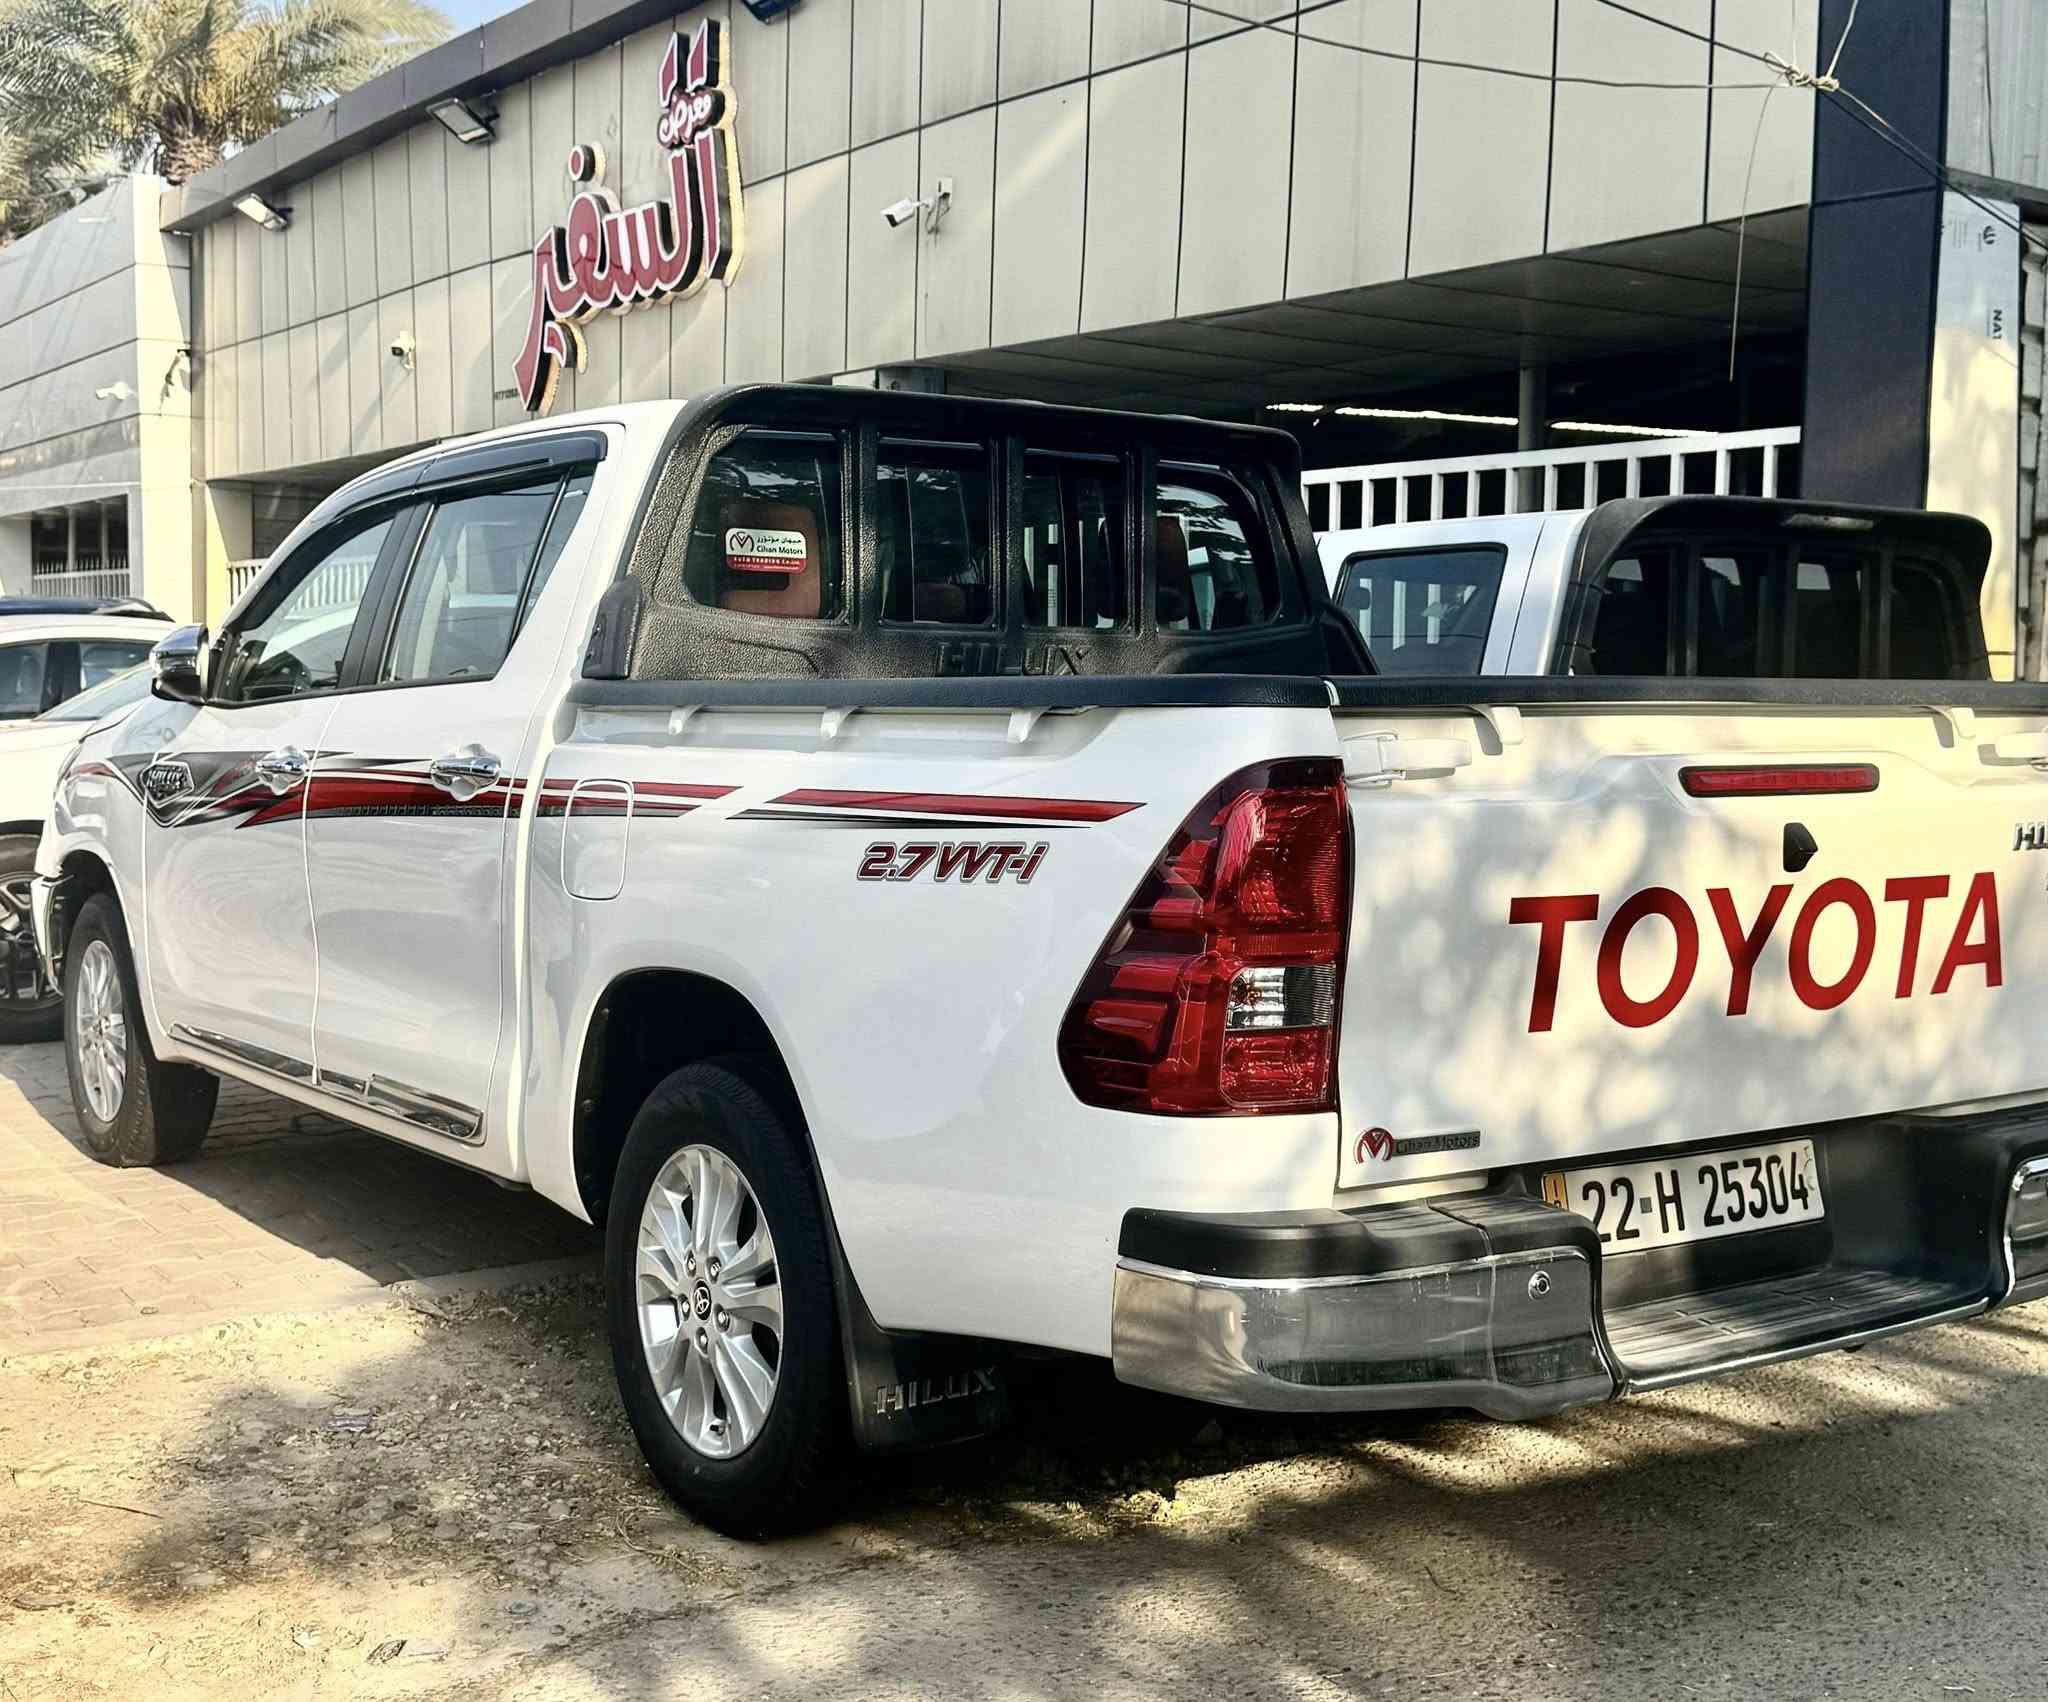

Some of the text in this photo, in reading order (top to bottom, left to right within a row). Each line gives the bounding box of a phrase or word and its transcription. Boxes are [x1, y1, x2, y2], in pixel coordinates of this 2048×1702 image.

[659, 92, 713, 144] معرض
[512, 17, 726, 412] السفير
[1509, 871, 2003, 1034] TOYOTA
[1699, 1151, 1809, 1227] 25304
[874, 1367, 996, 1414] HILUX
